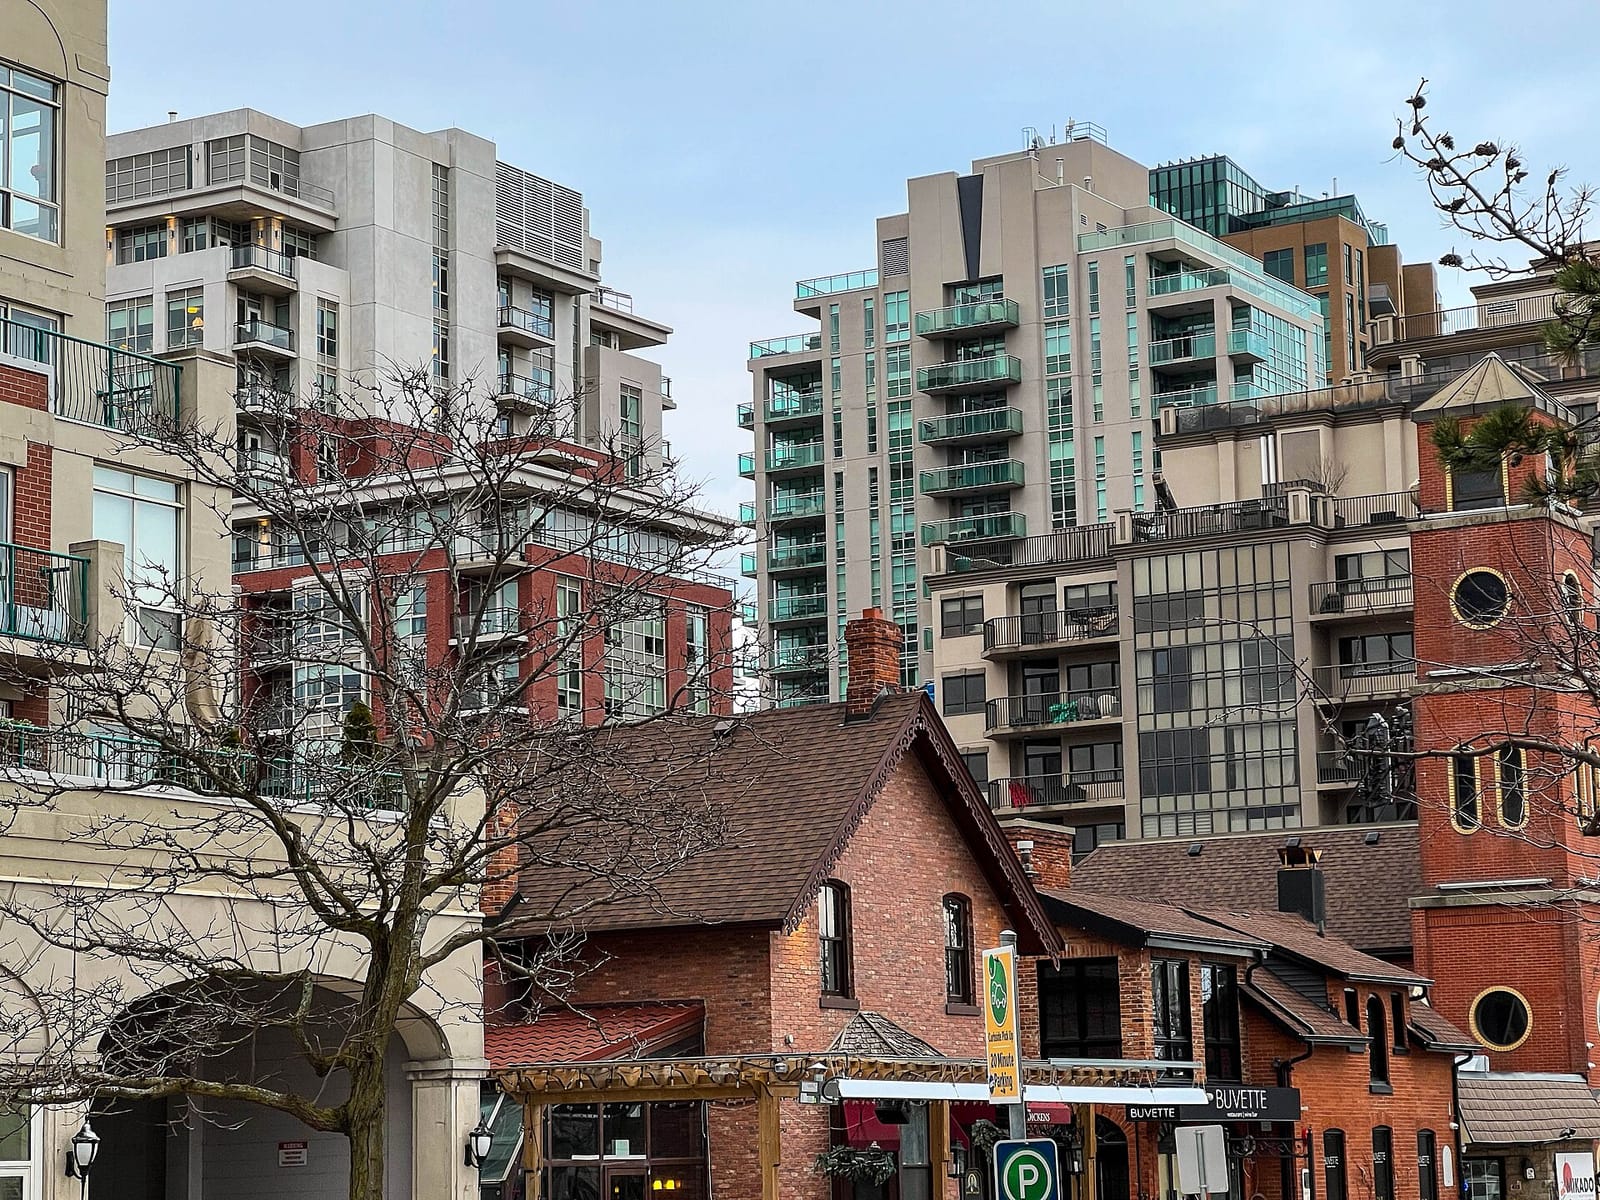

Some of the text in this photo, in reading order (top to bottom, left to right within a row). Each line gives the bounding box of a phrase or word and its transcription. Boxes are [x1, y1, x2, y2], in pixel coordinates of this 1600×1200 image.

[990, 1052, 1014, 1068] 20 Minute
[993, 1072, 1013, 1091] Parking
[1216, 1089, 1267, 1109] BUVETTE
[1130, 1108, 1175, 1118] BUVETTE
[1018, 1164, 1039, 1199] P
